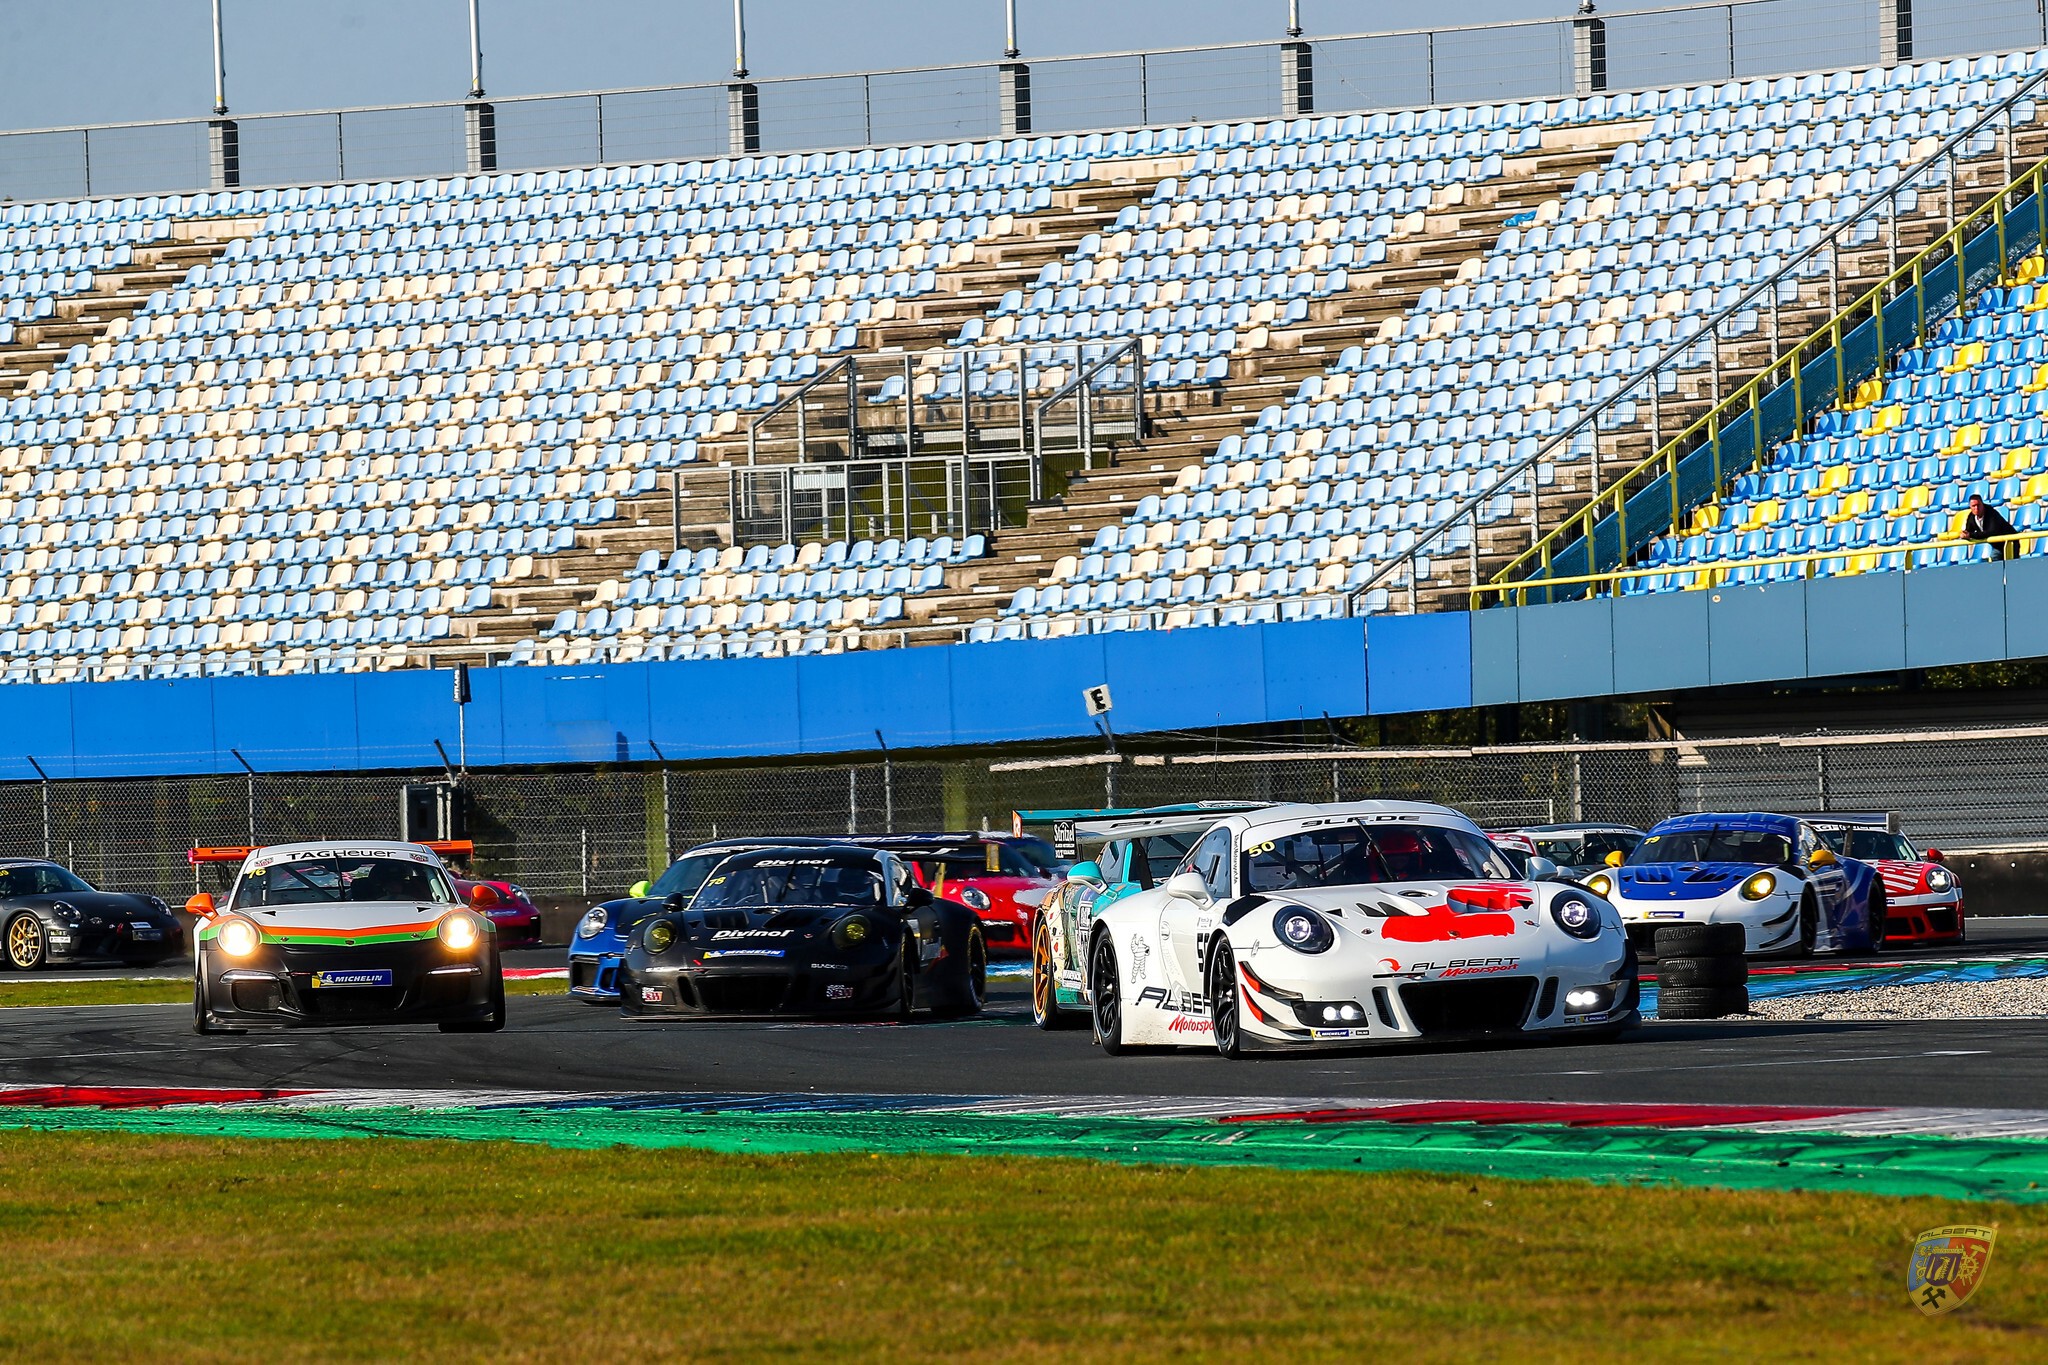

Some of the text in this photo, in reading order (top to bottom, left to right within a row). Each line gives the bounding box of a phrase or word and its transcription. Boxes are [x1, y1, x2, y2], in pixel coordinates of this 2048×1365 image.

[1090, 688, 1107, 710] E
[1248, 841, 1275, 857] 50
[1410, 957, 1521, 972] ALBERT
[1438, 963, 1519, 979] Motorsport
[335, 975, 383, 983] MICHELIN
[1168, 1014, 1214, 1035] Motorspo
